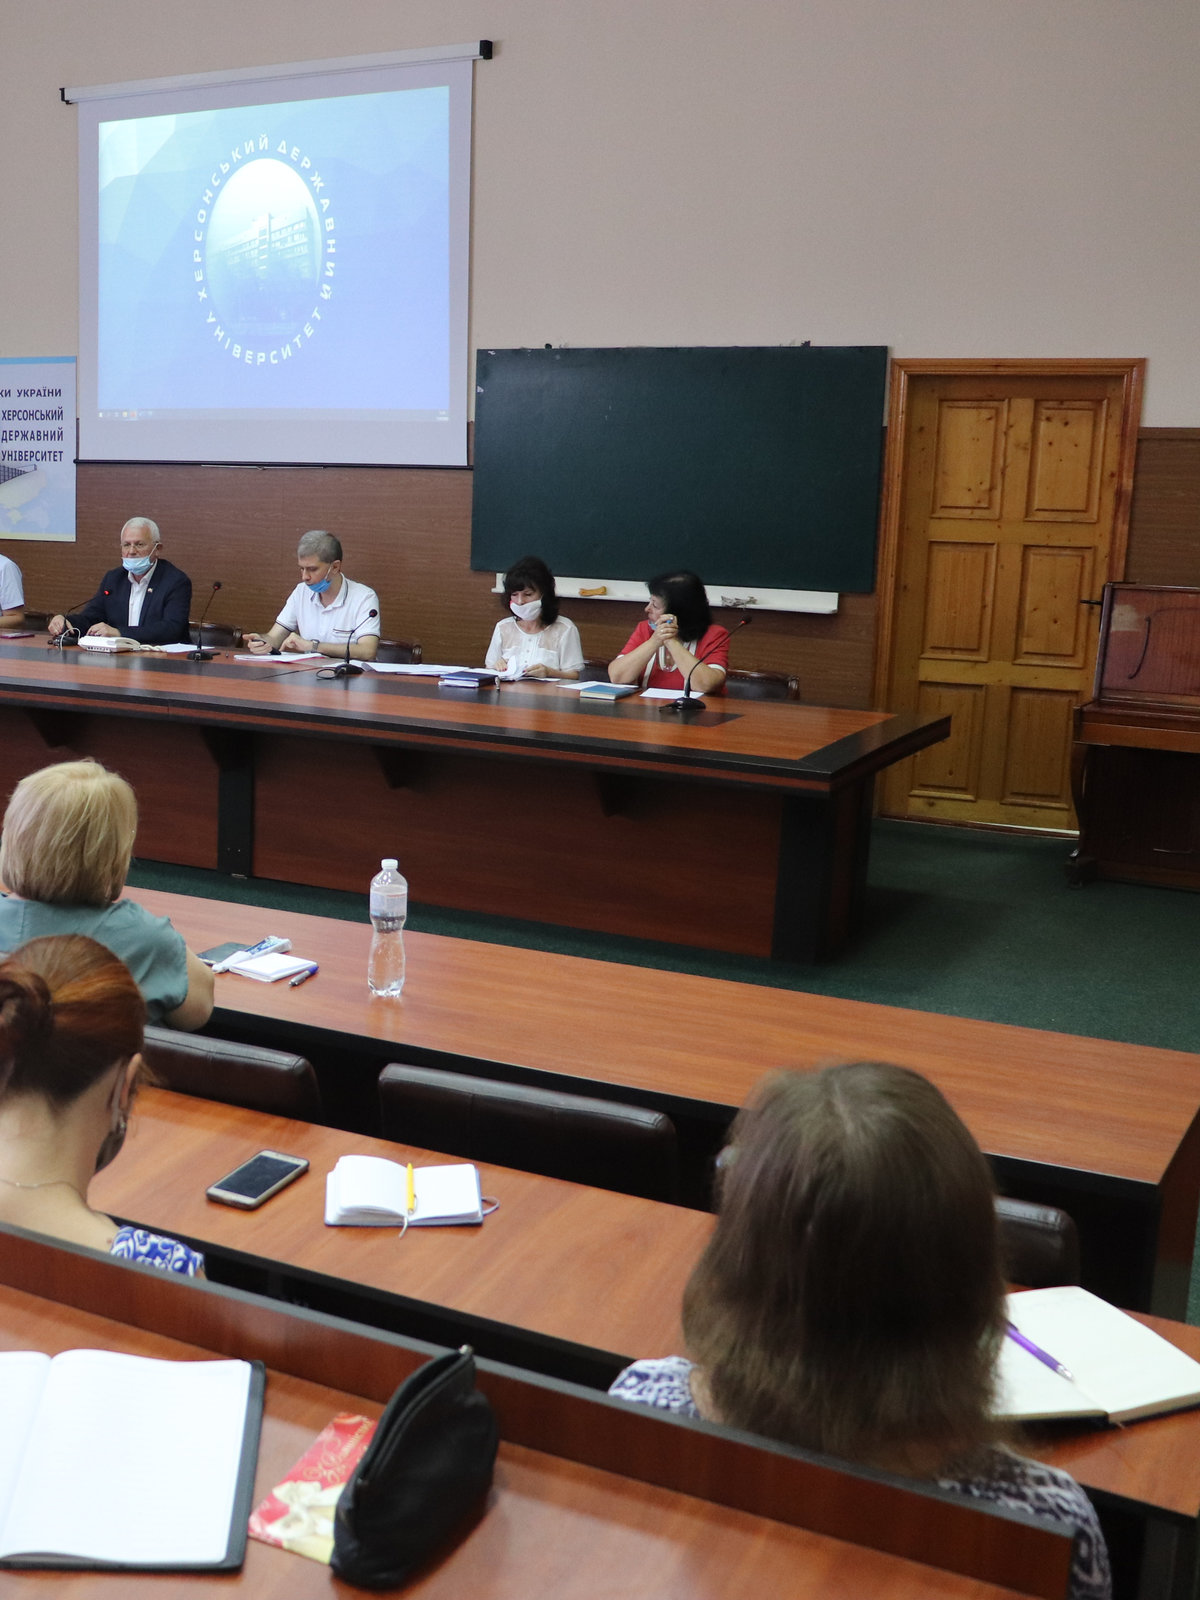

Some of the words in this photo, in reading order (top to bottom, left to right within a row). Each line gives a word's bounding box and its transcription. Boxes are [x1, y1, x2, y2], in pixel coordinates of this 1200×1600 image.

[193, 133, 269, 303] ХЕРСОНСЬКИЙ
[276, 139, 336, 300] ДЕРЖАВНИЙ
[206, 307, 322, 366] УНІВЕРСИТЕТ
[17, 388, 62, 397] УКРАЇНИ
[1, 407, 64, 421] ХЕРСОНСЬКИЙ
[1, 428, 64, 443] ДЕРЖАВНИЙ
[1, 450, 64, 462] УНІВЕРСИТЕТ
